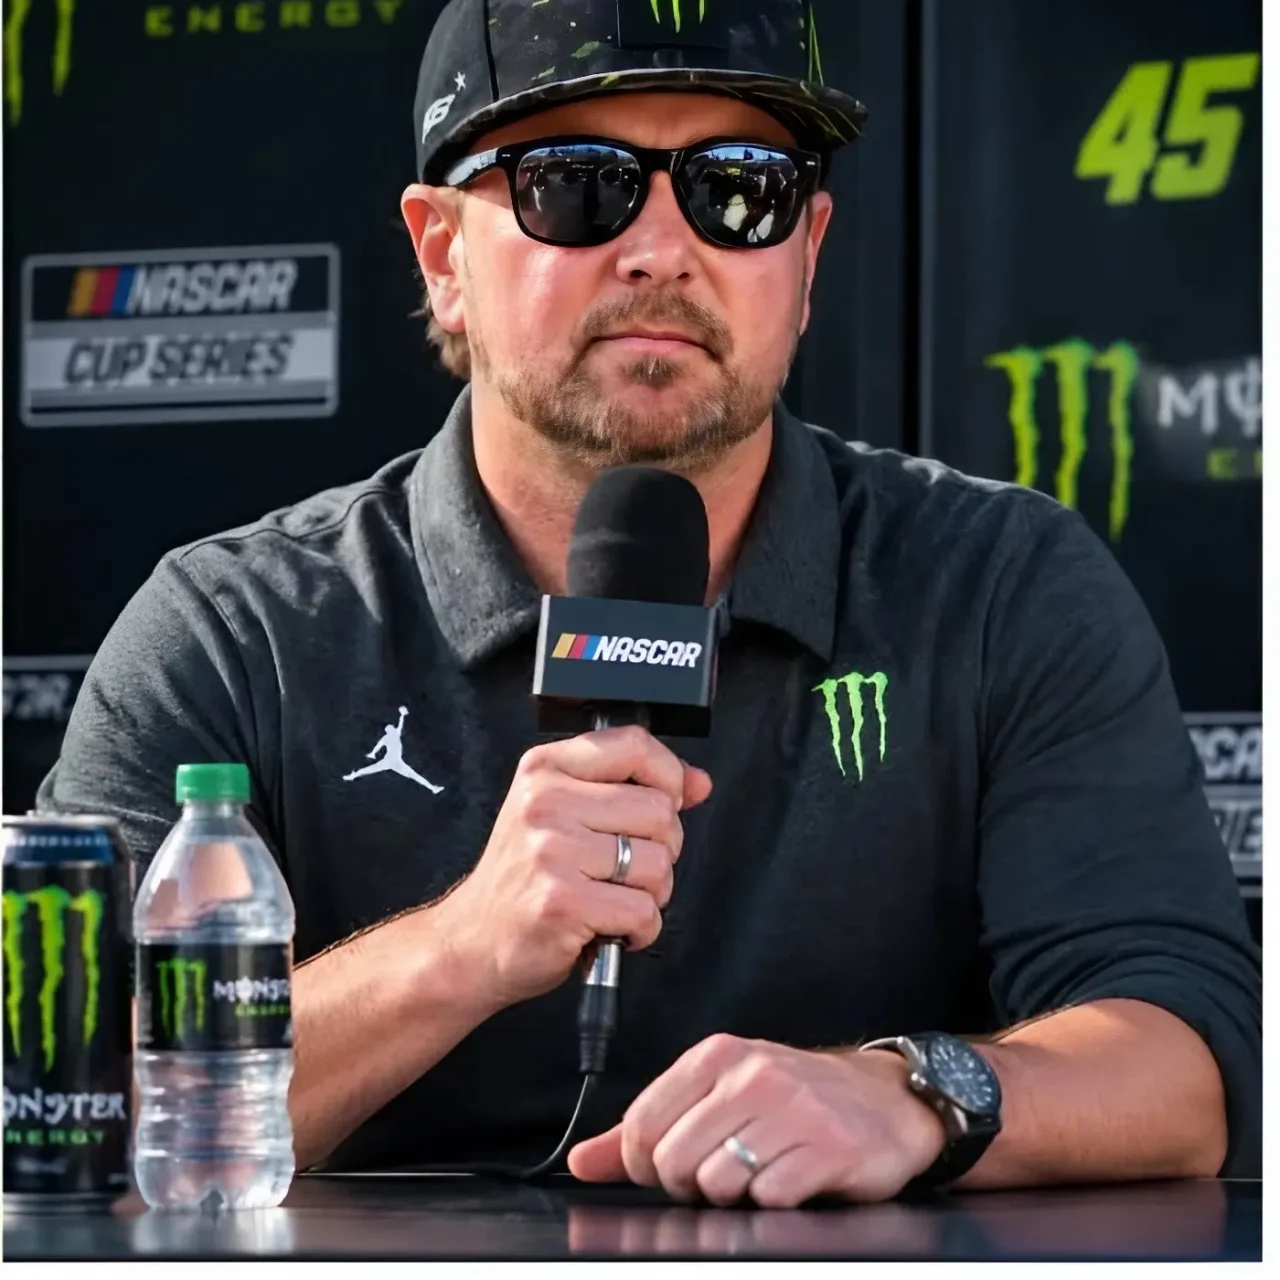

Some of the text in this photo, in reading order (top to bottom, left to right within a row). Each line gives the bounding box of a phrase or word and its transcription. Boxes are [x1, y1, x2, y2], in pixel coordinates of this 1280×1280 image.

[1073, 53, 1260, 206] 45
[126, 259, 298, 316] NASCAR
[592, 635, 703, 669] NASCAR
[2, 1086, 126, 1125] ONSTER
